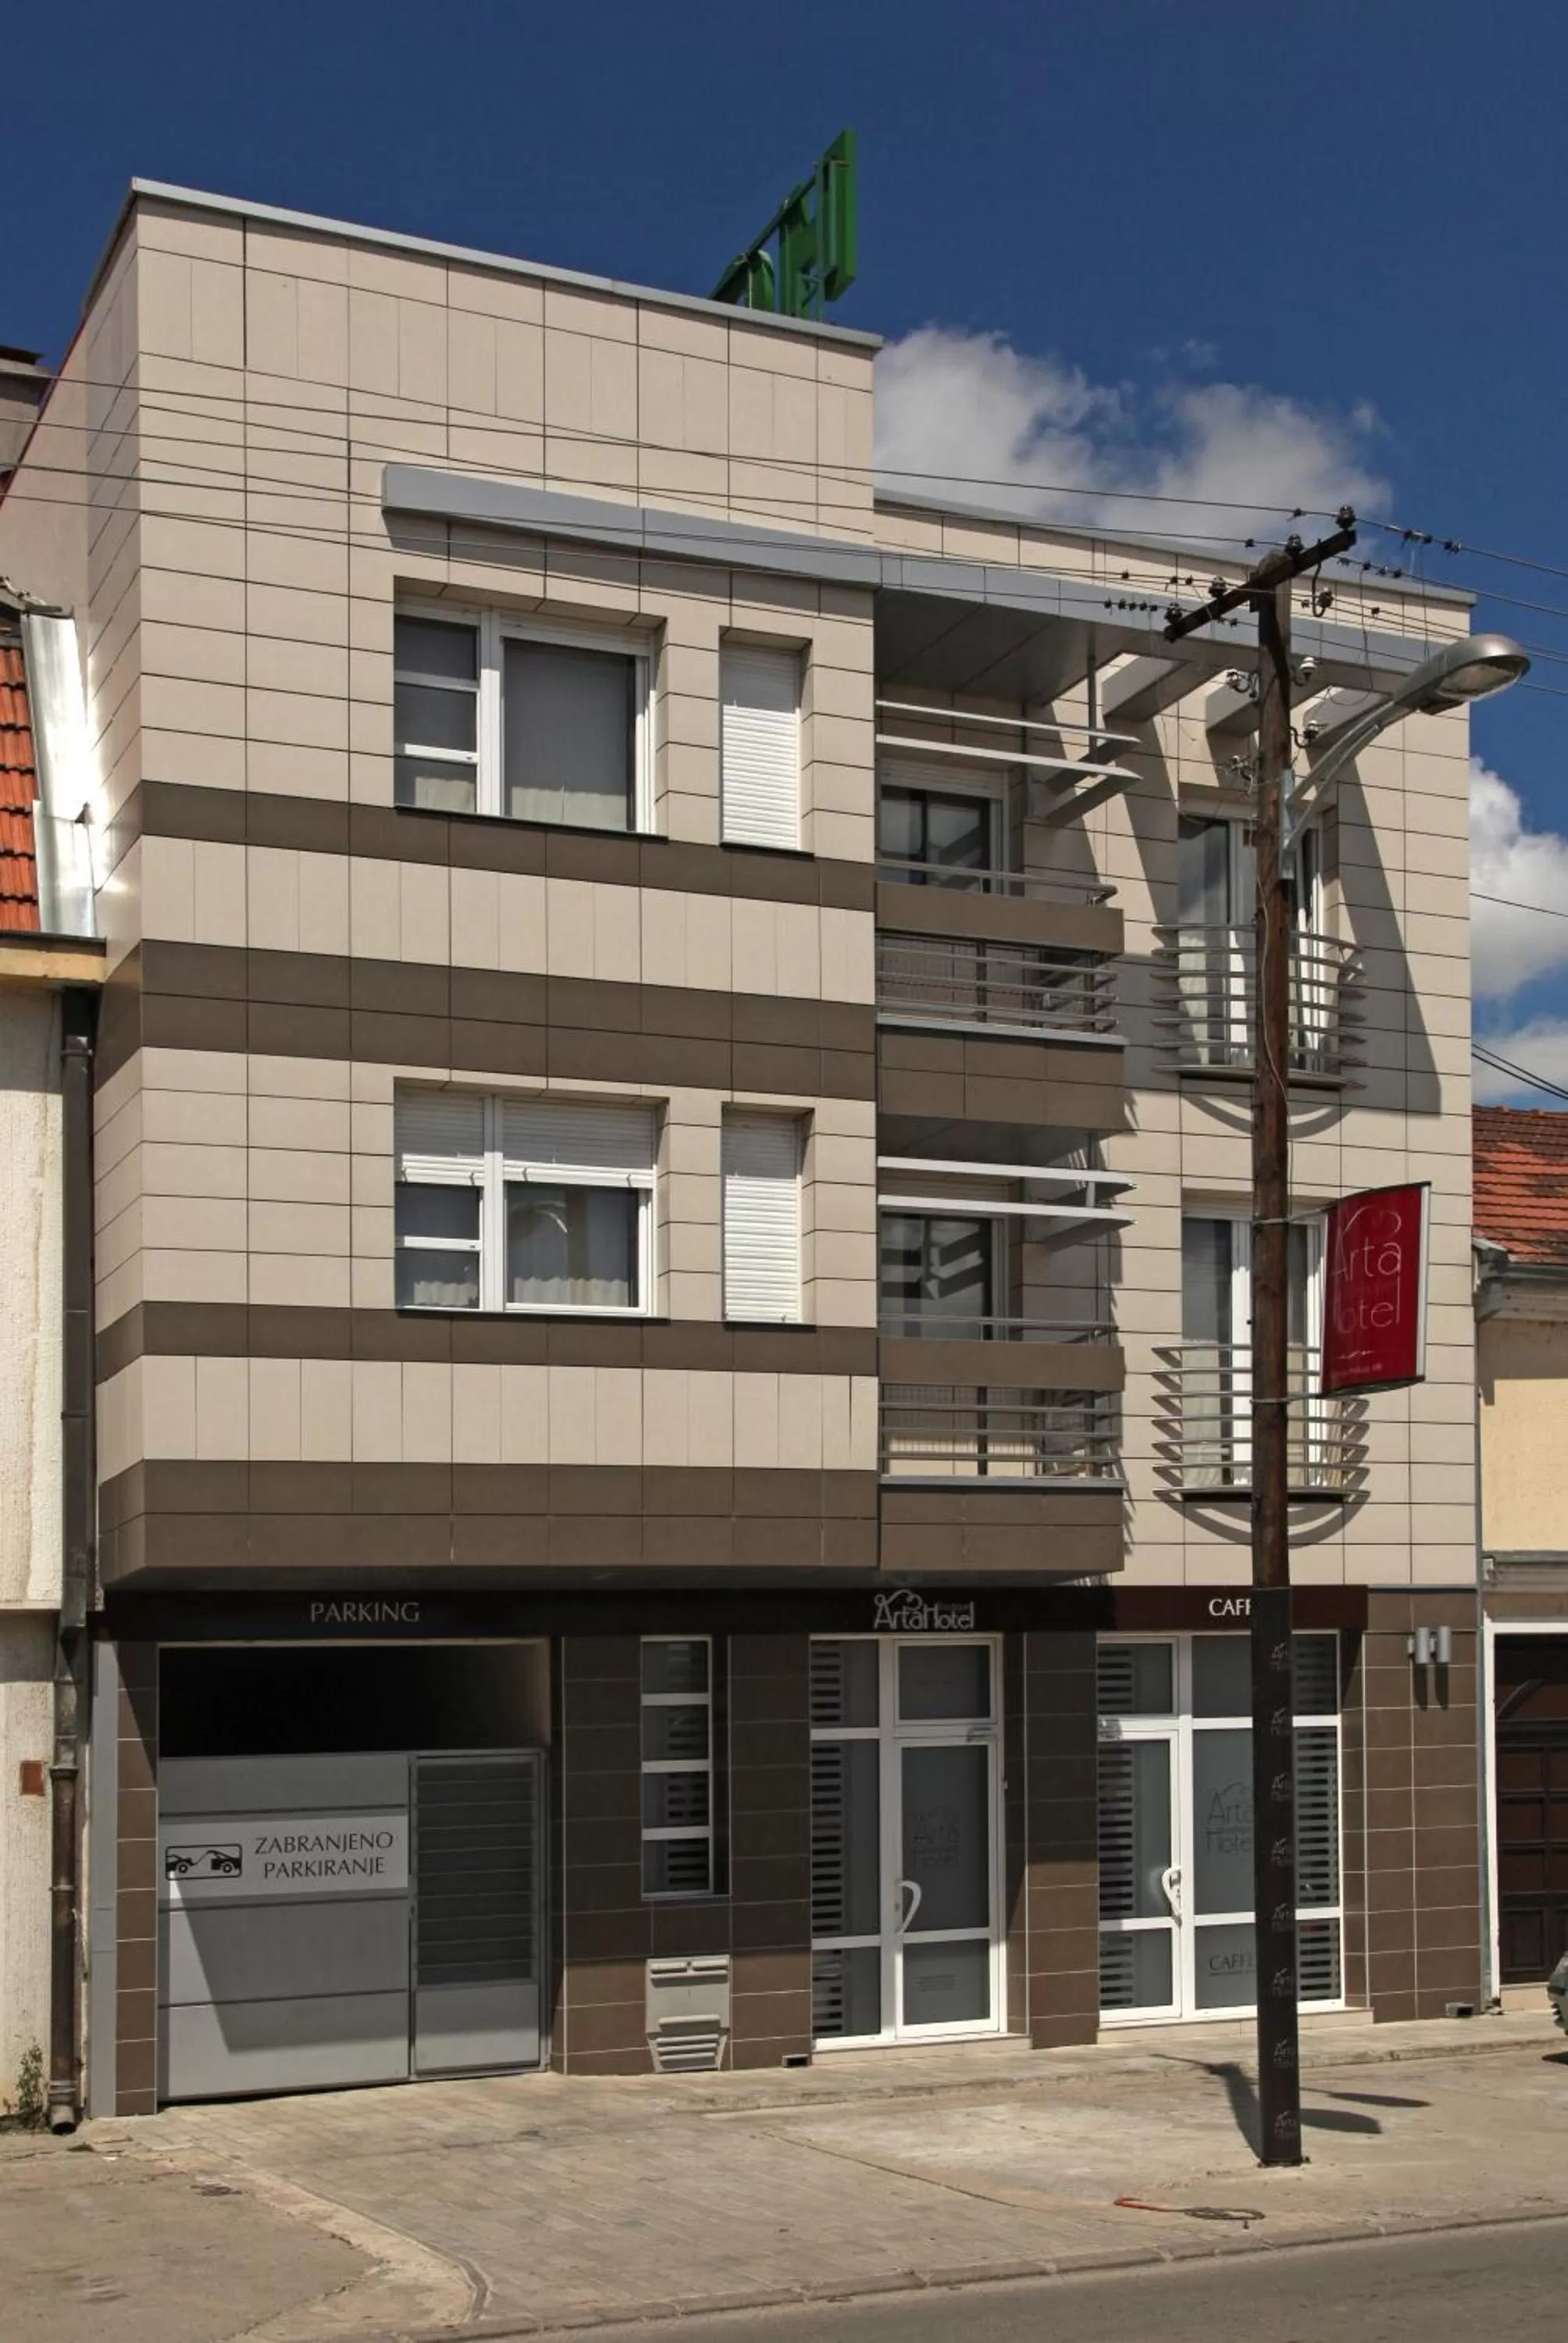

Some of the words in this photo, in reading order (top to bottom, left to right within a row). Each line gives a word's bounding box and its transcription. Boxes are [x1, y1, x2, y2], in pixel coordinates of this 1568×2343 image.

[310, 1601, 419, 1623] PARKING
[1209, 1598, 1251, 1616] CAFF
[255, 1831, 394, 1855] ZABRANJENO
[263, 1856, 386, 1880] PARKIRANJE
